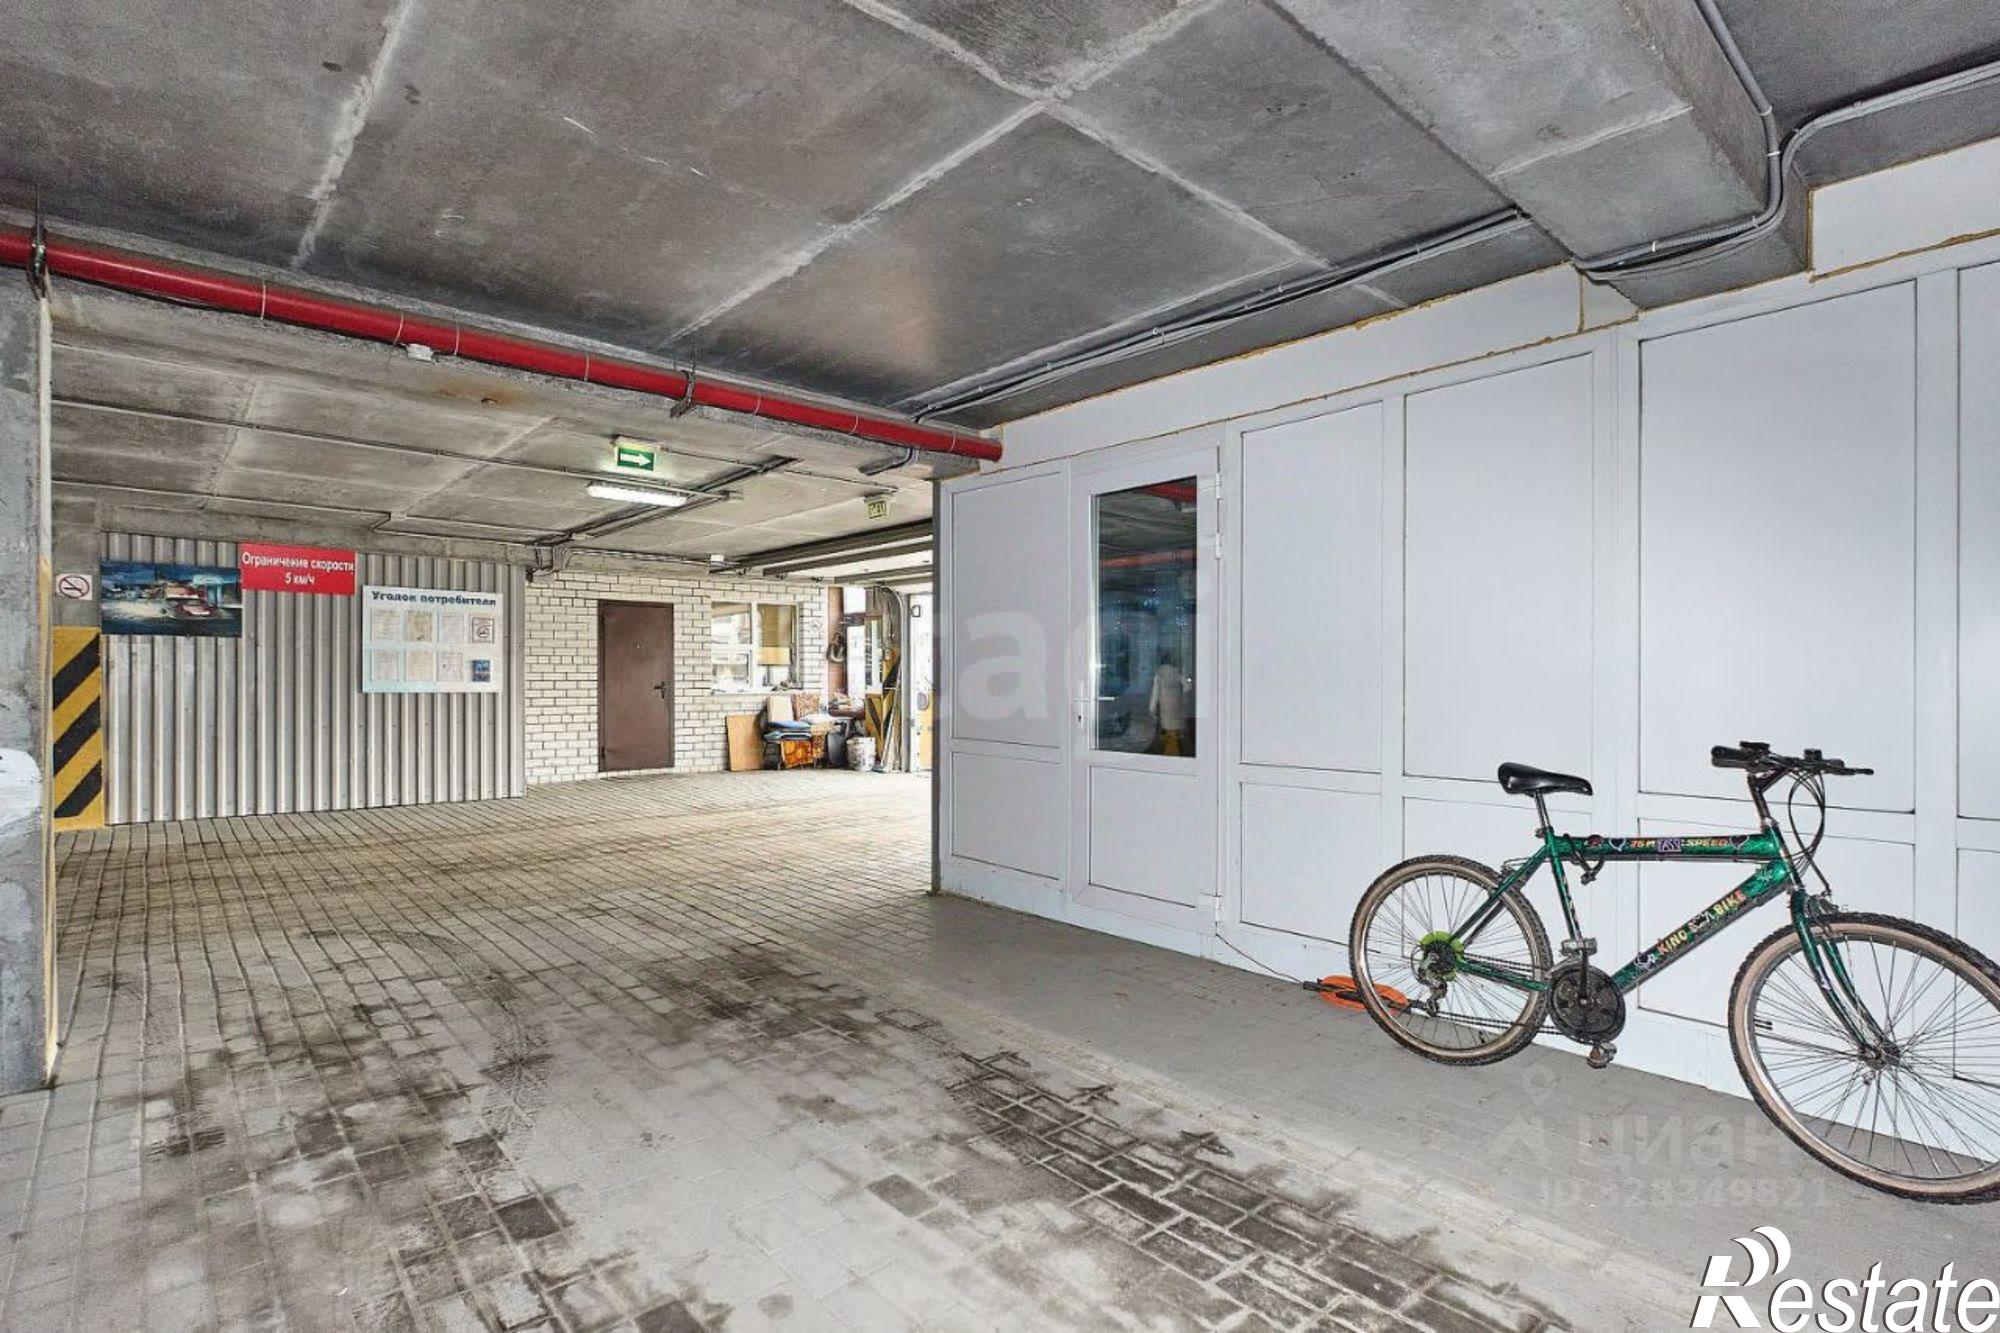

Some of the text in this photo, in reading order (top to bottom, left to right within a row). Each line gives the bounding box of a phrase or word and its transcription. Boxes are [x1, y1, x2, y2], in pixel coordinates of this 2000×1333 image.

[241, 551, 354, 574] Ограничение скорости
[285, 572, 315, 585] 5 км/ч
[372, 590, 496, 606] Уголок потребителя
[1713, 889, 1747, 916] BIKE
